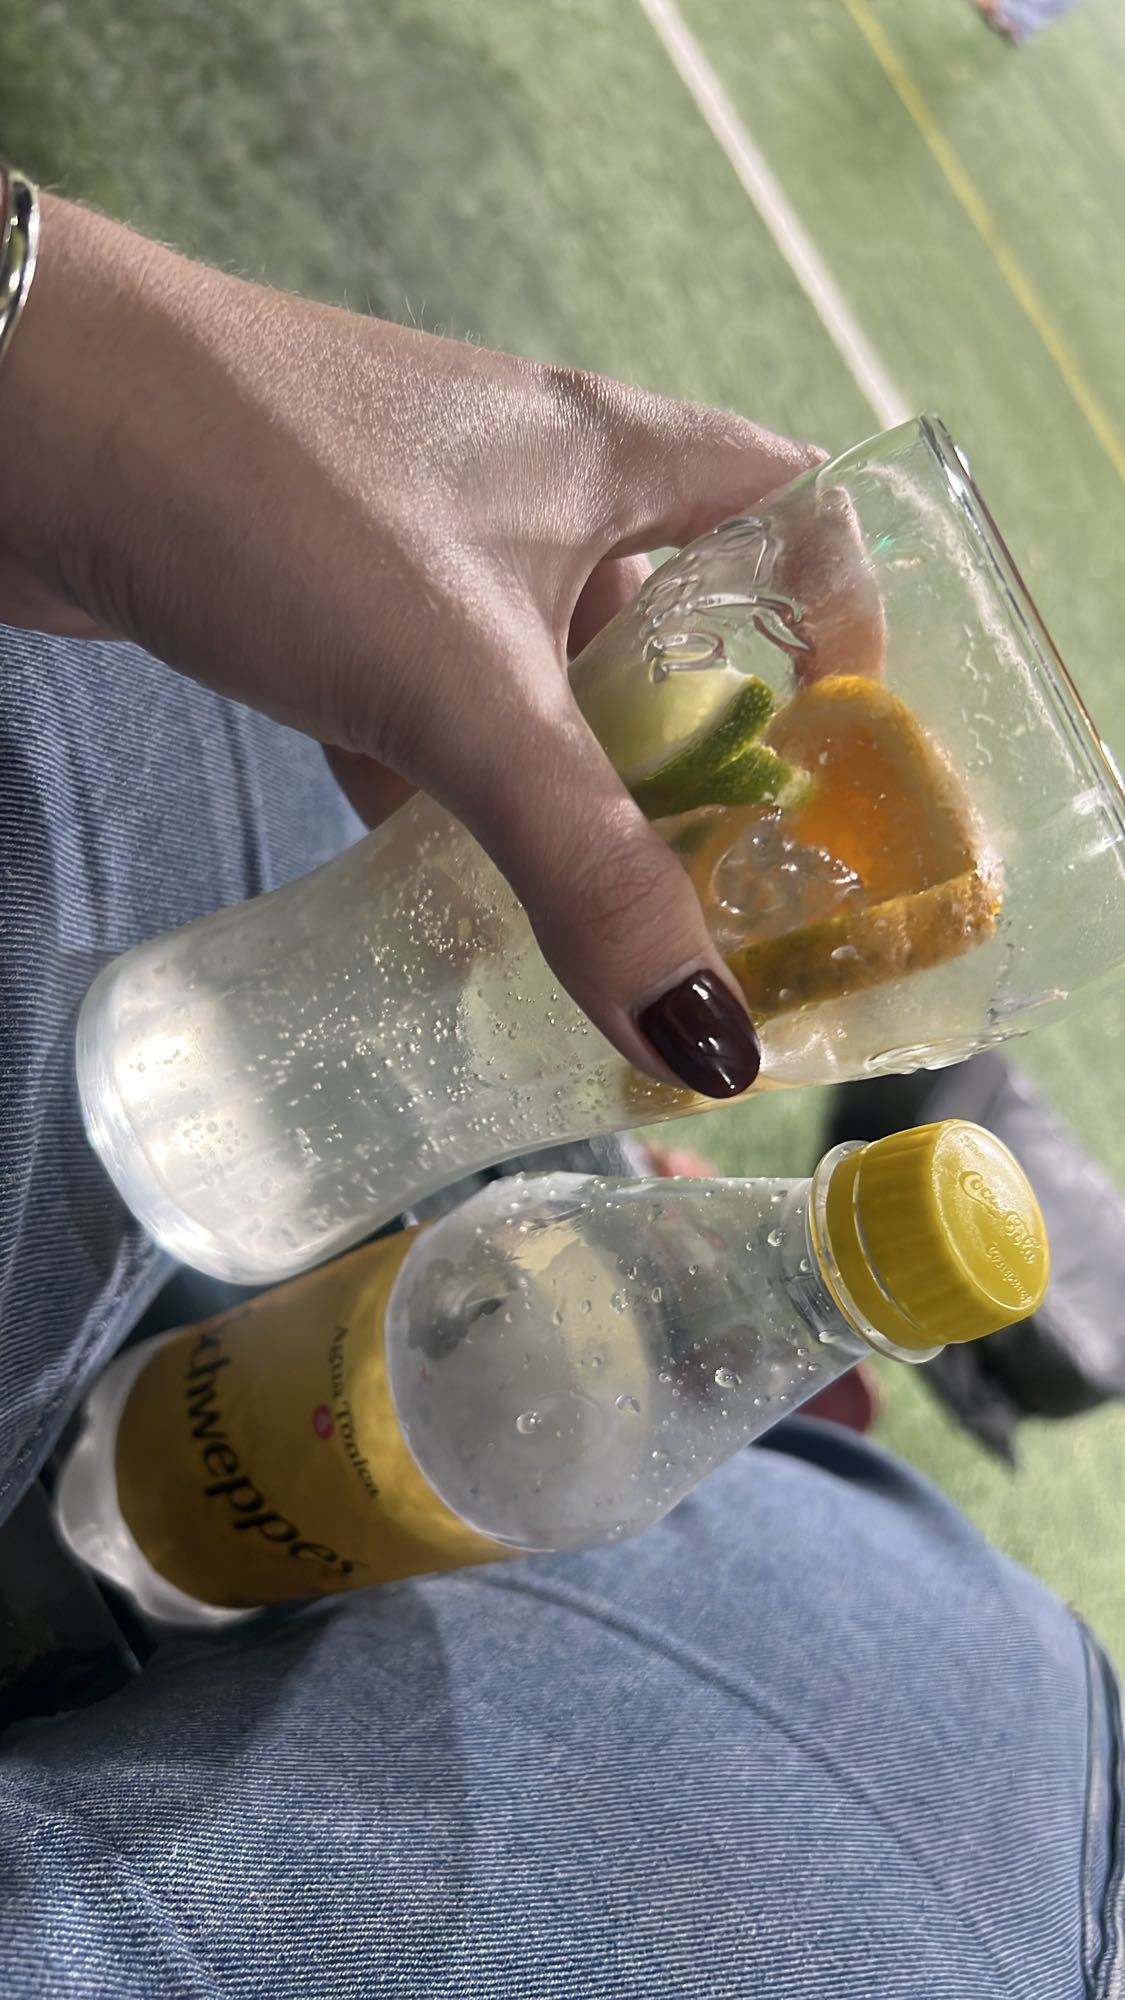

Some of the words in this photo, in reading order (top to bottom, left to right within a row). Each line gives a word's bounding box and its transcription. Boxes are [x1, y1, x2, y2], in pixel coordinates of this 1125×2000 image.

[958, 1170, 1040, 1264] Coca-Cola
[328, 1325, 347, 1398] Agua
[184, 1329, 369, 1575] chweppes
